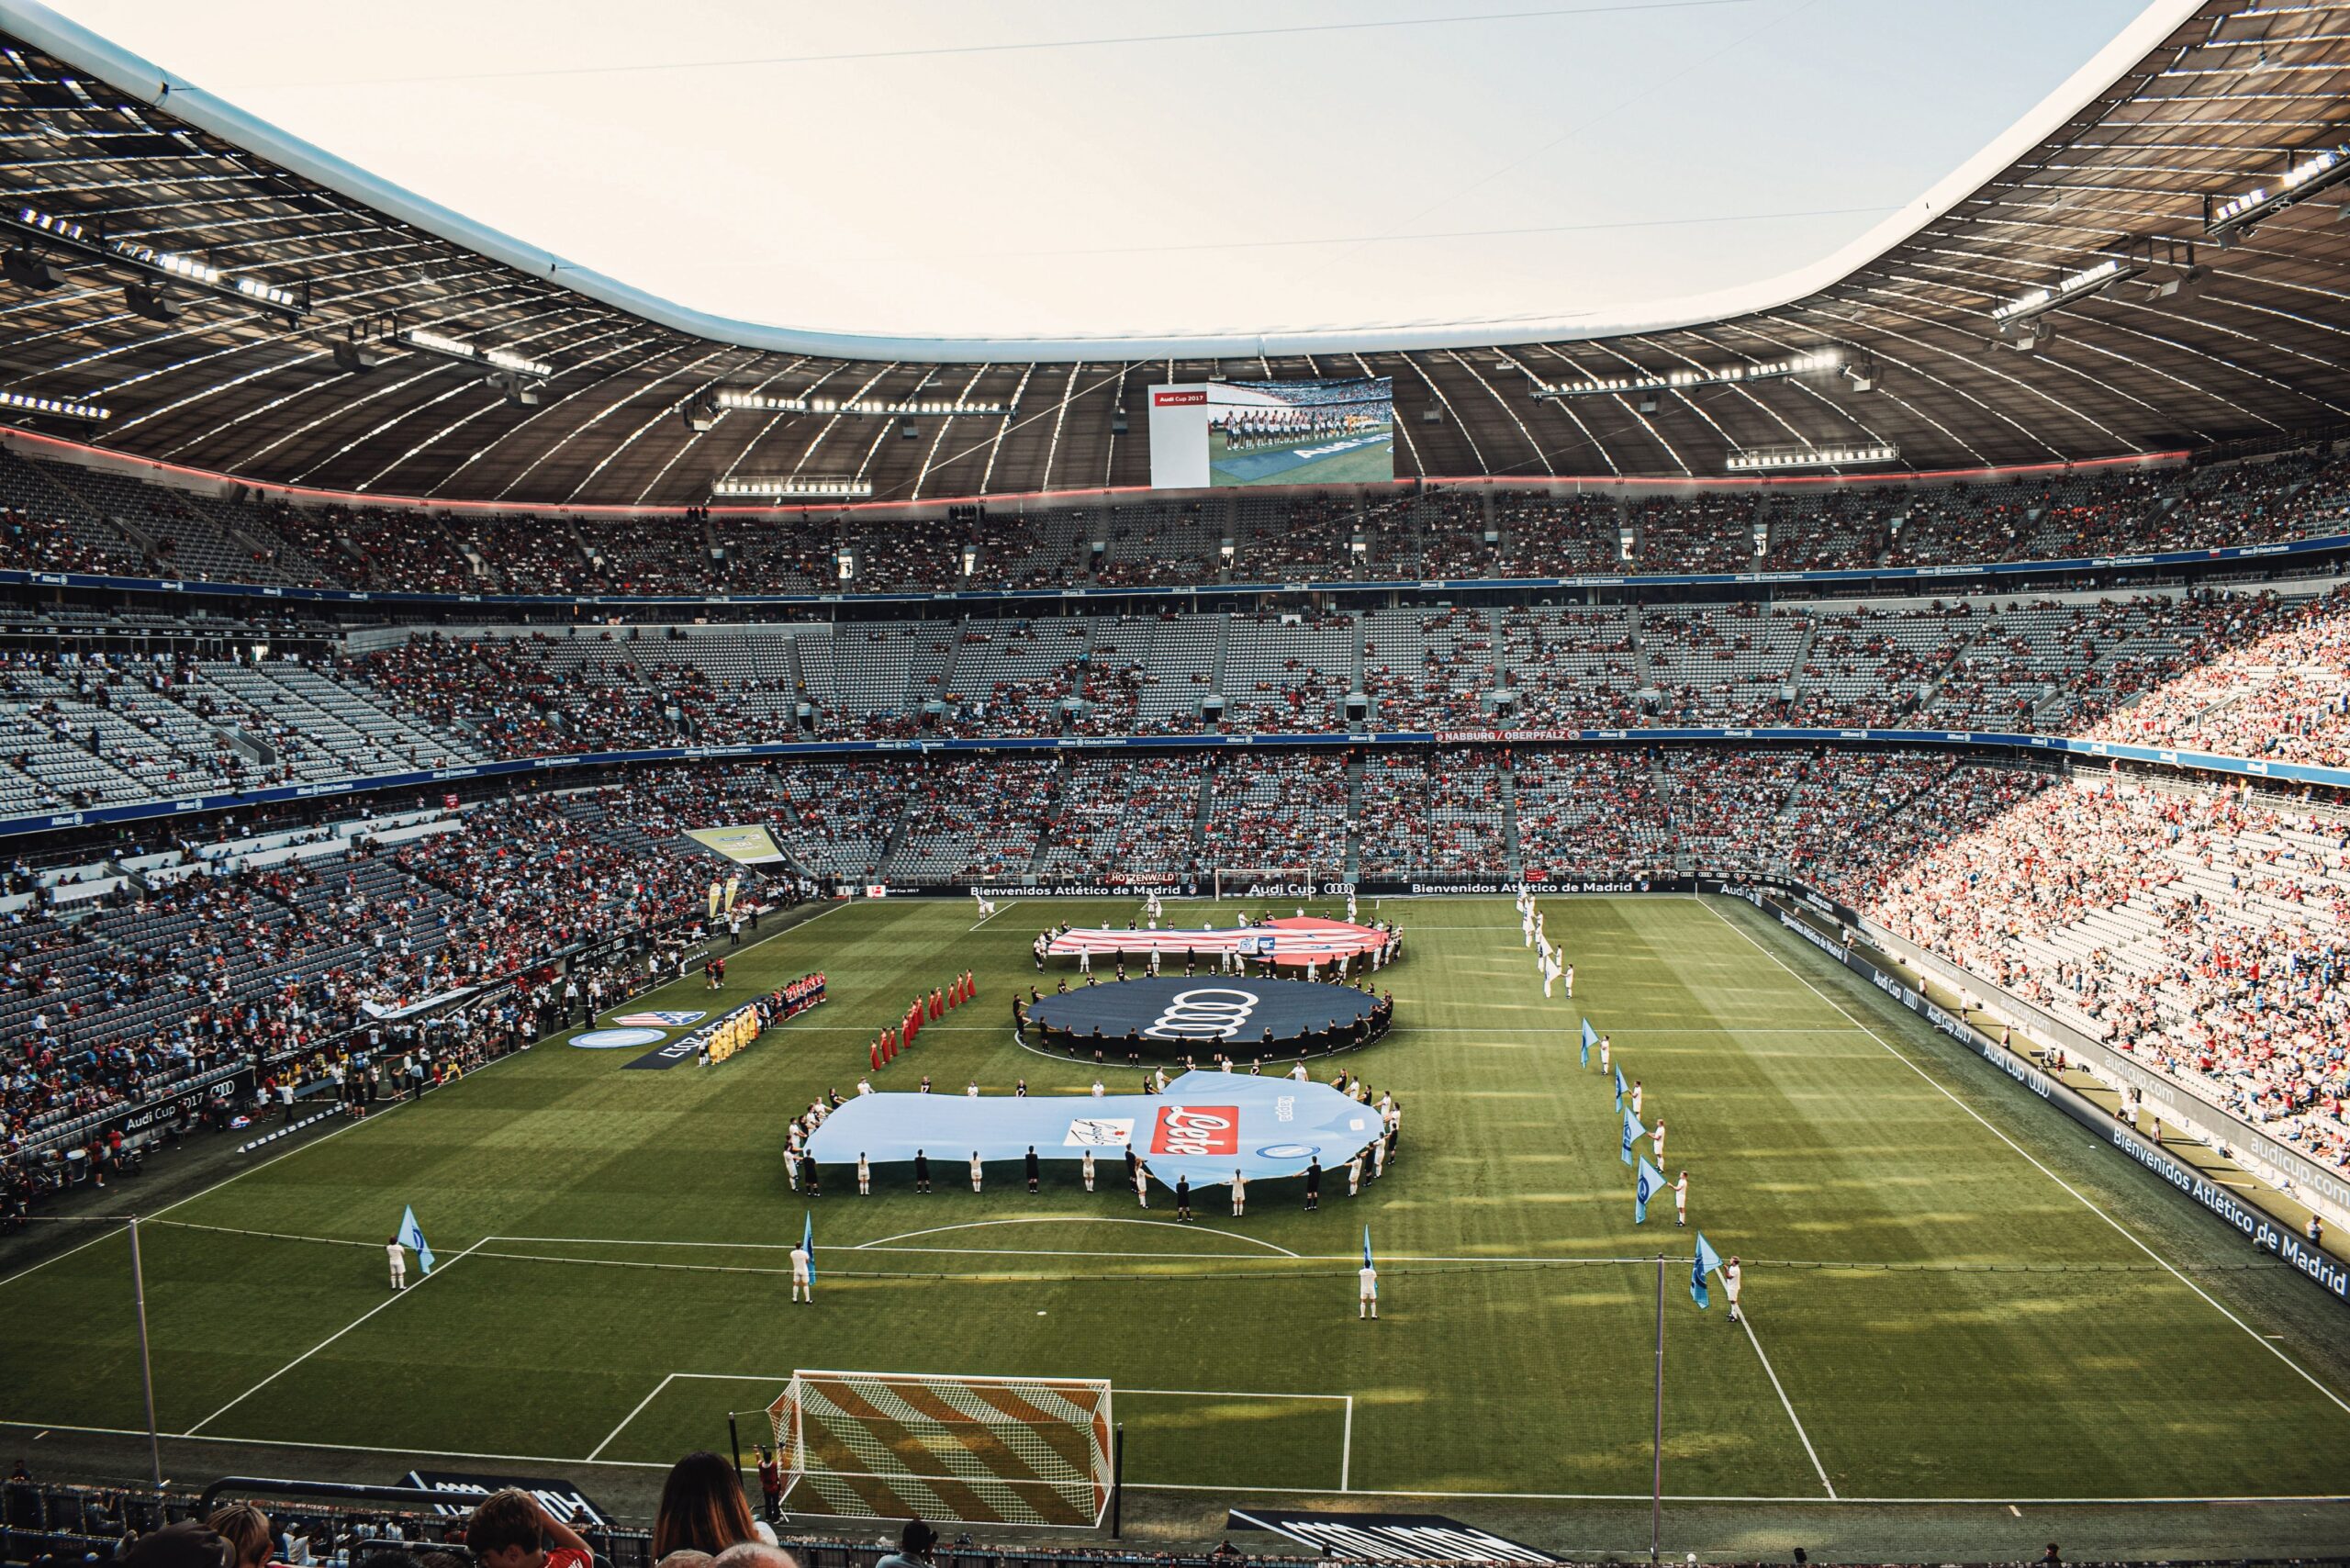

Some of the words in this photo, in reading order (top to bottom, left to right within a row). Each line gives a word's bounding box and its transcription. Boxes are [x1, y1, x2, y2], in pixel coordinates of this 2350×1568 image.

[1445, 732, 1496, 742] NABBURG
[1505, 730, 1566, 741] OBERPFALZ
[52, 815, 74, 826] Allianz
[1112, 873, 1174, 882] HOTZENWALD
[1249, 885, 1283, 894] Audi
[1287, 885, 1317, 896] Cup
[1412, 883, 1497, 893] Bienvenidos
[1501, 882, 1558, 892] Atético
[1561, 882, 1580, 892] de
[1583, 882, 1632, 892] Madrid
[1719, 883, 1744, 896] Audi
[970, 887, 1051, 896] Bienvenidos
[1055, 886, 1108, 895] Atlético
[1113, 886, 1129, 895] de
[1134, 886, 1181, 895] Madrid
[599, 944, 611, 955] 2017
[1827, 939, 1842, 959] Madrid
[1874, 969, 1889, 991] Audi
[1888, 979, 1901, 999] Cup
[1927, 1005, 1942, 1025] Audi
[1942, 1015, 1954, 1036] Cup
[1954, 1023, 1972, 1044] 2017
[2000, 995, 2051, 1034] audicup.com
[1984, 1041, 2006, 1069] Audi
[2006, 1055, 2025, 1081] Cup
[2104, 1054, 2176, 1104] audicup.com
[127, 1111, 153, 1131] Audi
[155, 1105, 176, 1121] Cup
[1275, 1095, 1294, 1122] Kappa
[1164, 1106, 1231, 1155] Lete
[2250, 1137, 2350, 1208] audicup.com
[2113, 1126, 2191, 1191] Bienvenidos
[2192, 1179, 2254, 1233] Atlético
[2257, 1222, 2278, 1249] de
[2282, 1235, 2347, 1295] Madrid
